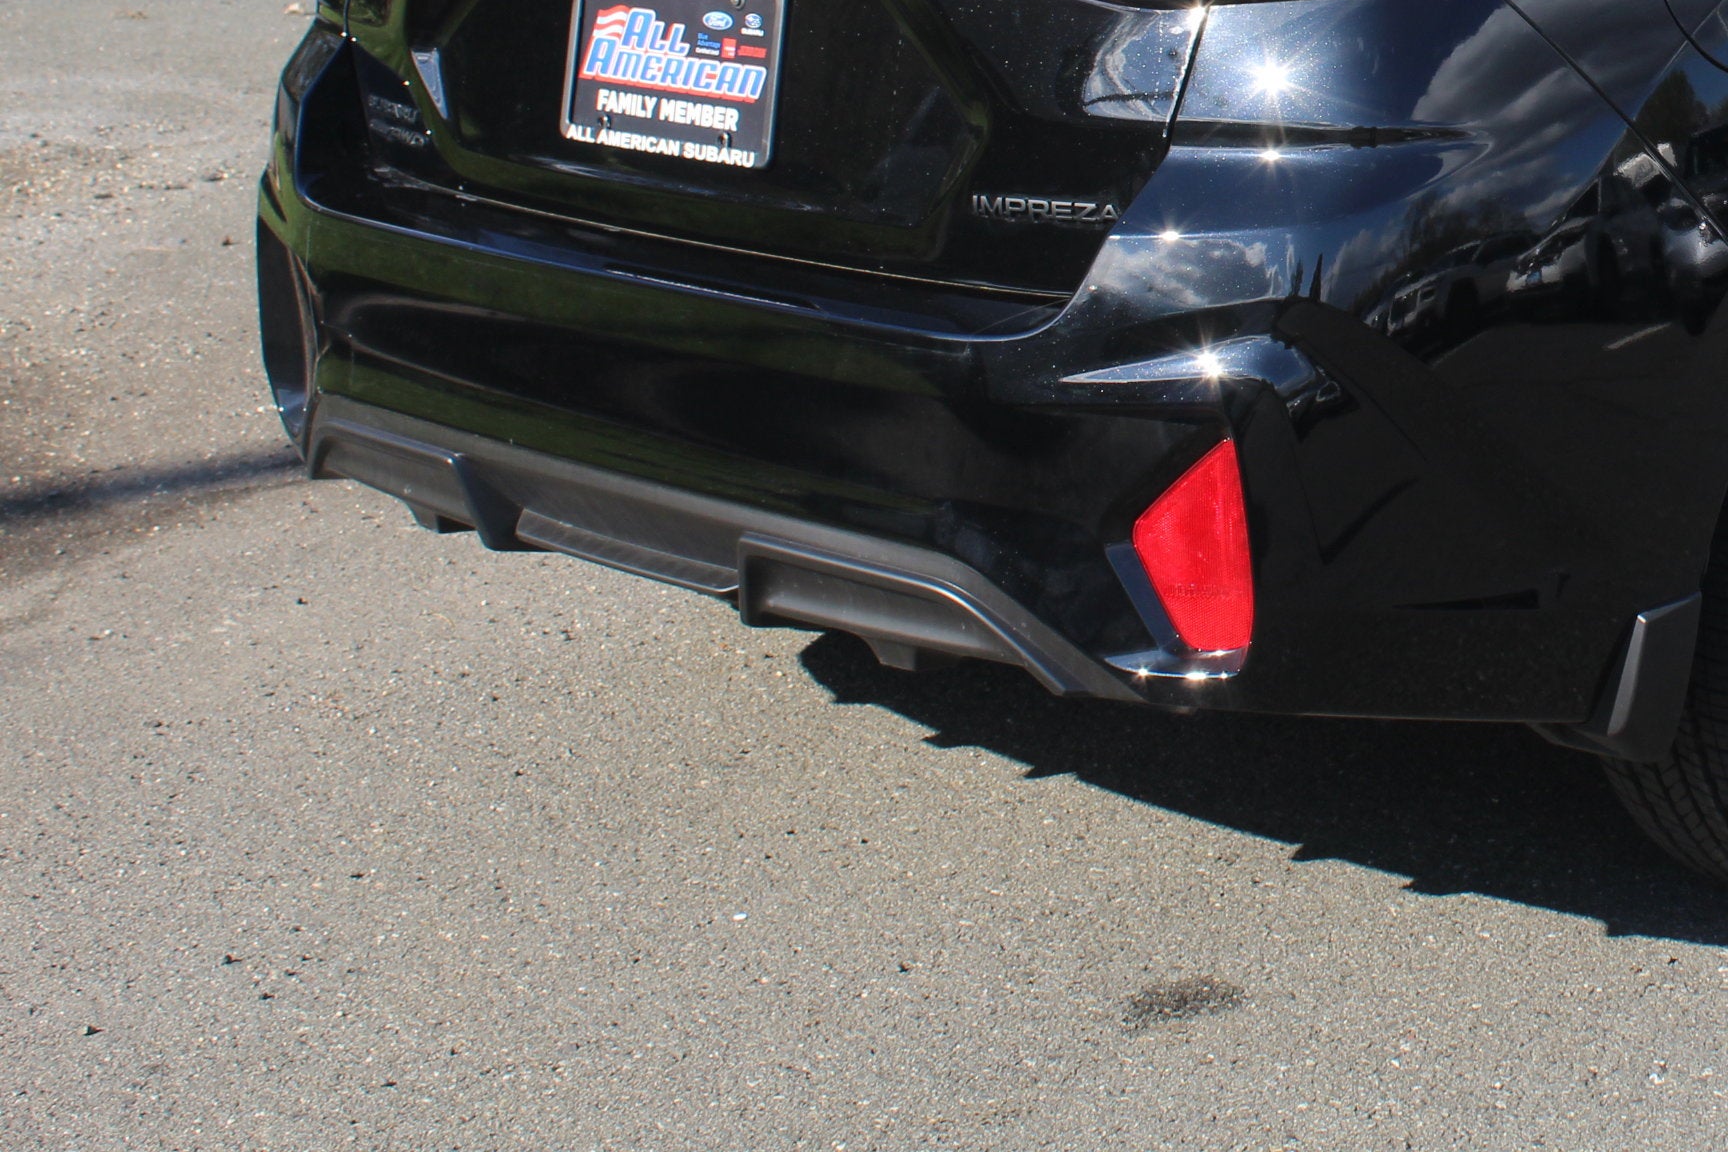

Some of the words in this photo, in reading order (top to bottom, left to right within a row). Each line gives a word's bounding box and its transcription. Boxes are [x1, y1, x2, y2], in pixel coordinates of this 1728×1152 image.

[620, 7, 690, 56] ALL
[583, 35, 767, 100] AMERICAN
[597, 88, 657, 119] FAMILY
[659, 97, 739, 132] MEMBER
[566, 124, 596, 144] ALL
[597, 128, 680, 158] AMERICAN
[682, 142, 756, 168] SUBARU
[972, 195, 1119, 221] IMPREZA
